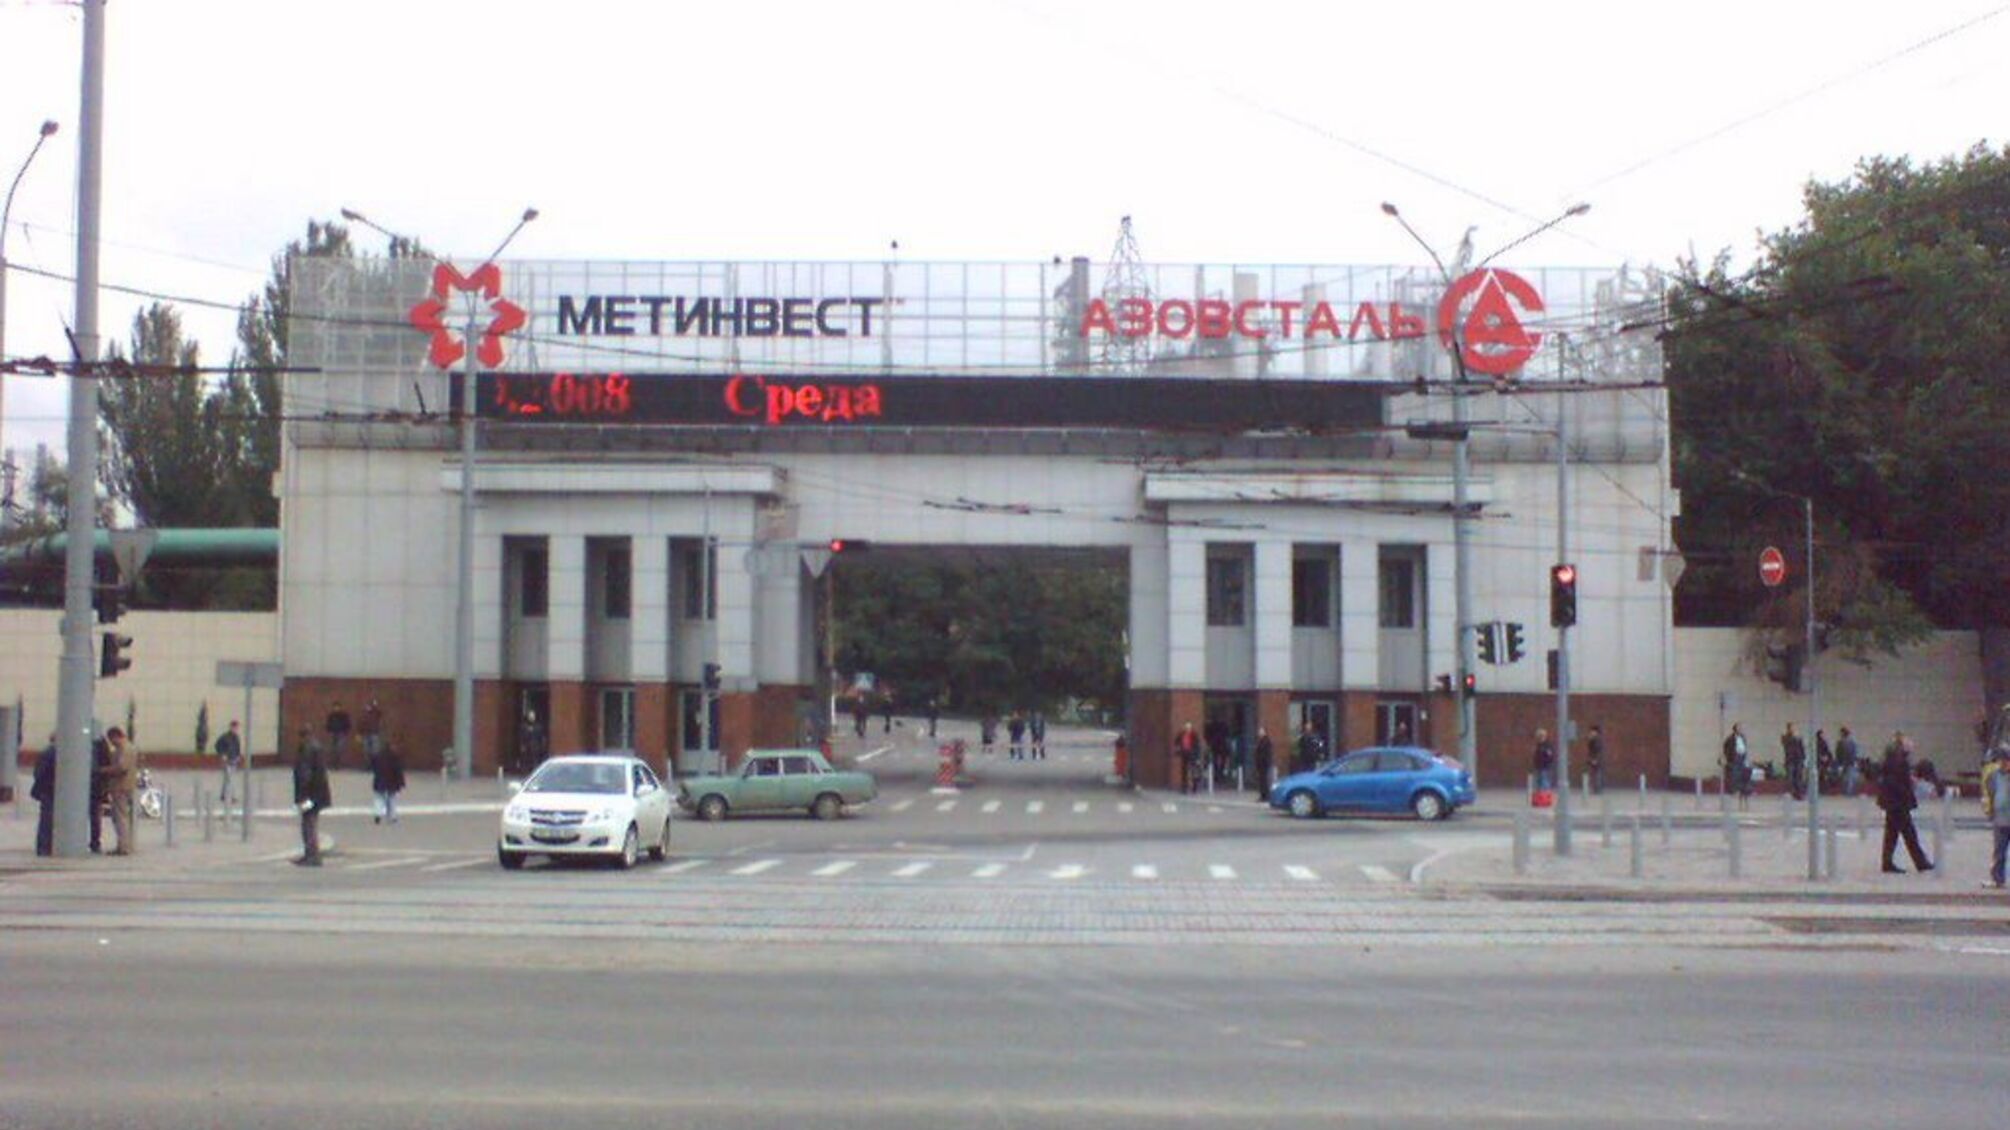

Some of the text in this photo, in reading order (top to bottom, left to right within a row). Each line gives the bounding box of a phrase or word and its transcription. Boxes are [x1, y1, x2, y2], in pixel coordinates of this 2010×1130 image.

[558, 295, 883, 337] МЕТИНВЕСТ
[1080, 299, 1426, 338] АЗОВСТАЛЬ
[725, 374, 881, 424] Среда
